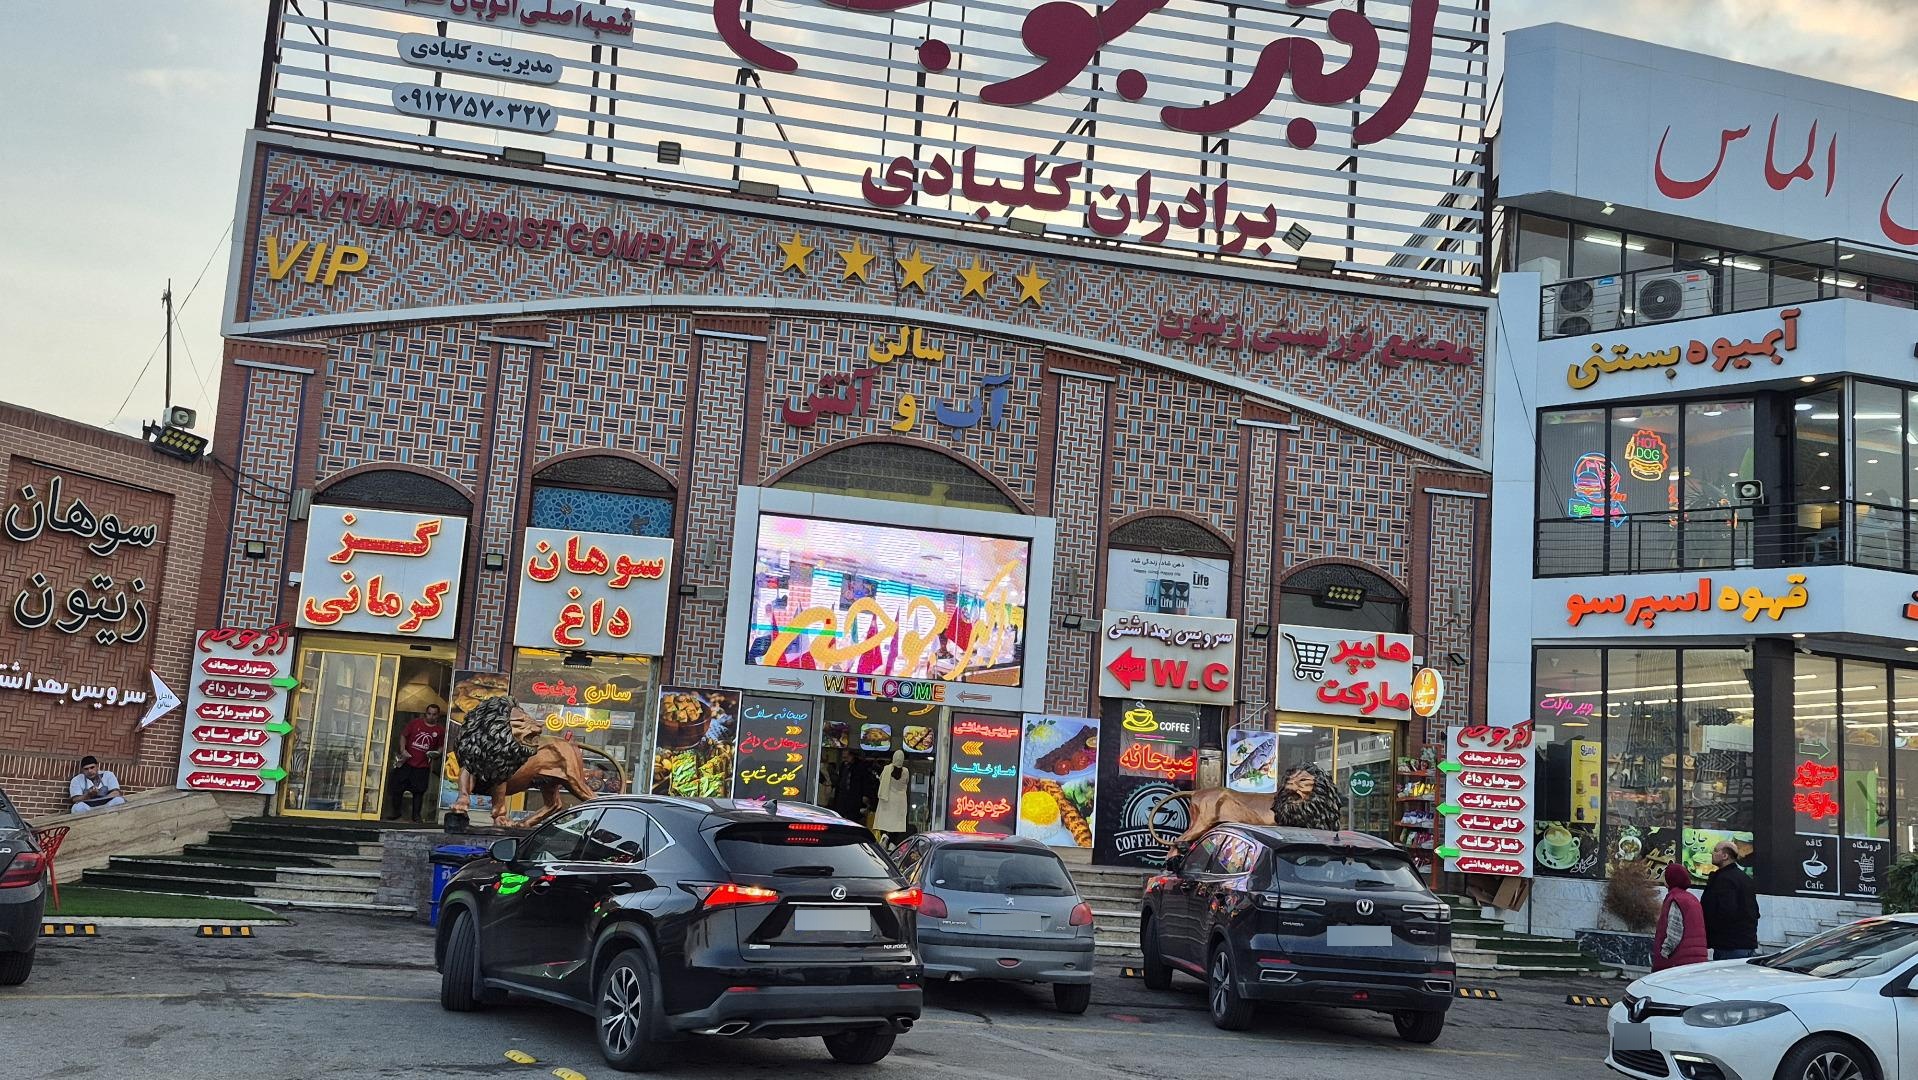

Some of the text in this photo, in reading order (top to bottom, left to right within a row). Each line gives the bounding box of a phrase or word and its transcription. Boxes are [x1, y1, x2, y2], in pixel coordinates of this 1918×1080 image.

[520, 3, 582, 28] اصلی
[581, 7, 633, 38] شعبه
[410, 41, 471, 64] کلبادی
[487, 52, 553, 75] مدیریت
[400, 88, 551, 127] ۰۹۱۲۷۵۷۰۳۲۷
[1655, 113, 1837, 199] الماس
[861, 145, 1277, 257] برادران کلبادی
[268, 183, 733, 272] ZAYTUN TOURIST COMPLEX
[265, 235, 369, 287] VIP
[868, 324, 945, 364] سالن
[1158, 308, 1244, 350] زیتون
[1380, 333, 1475, 374] مجتمع
[1566, 308, 1801, 390] آبمیوه بستنی
[891, 391, 917, 432] و
[935, 373, 1011, 441] آب
[1636, 437, 1657, 448] HOT
[1636, 449, 1660, 460] DOG
[5, 475, 157, 556] سوهان
[327, 512, 442, 564] گز
[526, 535, 666, 589] سوهان
[14, 572, 148, 645] زیتون
[303, 570, 452, 633] کرمانی
[552, 586, 633, 648] داغ
[1566, 573, 1809, 629] قهوه اسپرسو
[1107, 615, 1233, 649] سرویس بهداشتی
[1330, 634, 1412, 675] هایپر
[0, 661, 147, 709] سرویس بهداشت
[205, 683, 268, 699] سوهان داغ
[584, 684, 631, 704] سالن
[824, 675, 946, 702] WELLCOME
[1316, 679, 1412, 714] مارکت
[198, 728, 262, 743] کافی شاپ
[546, 711, 611, 732] سوهان
[1159, 721, 1190, 733] COFFEE
[740, 764, 804, 784] کافی شاپ
[1119, 743, 1194, 779] صبحانه
[1463, 774, 1520, 788] سوهان داغ
[1462, 816, 1519, 830] کافی شاپ
[1806, 839, 1822, 847] کافه
[1852, 841, 1882, 852] فروشگاه
[1805, 880, 1824, 890] Cafe
[1858, 884, 1877, 894] Shop
